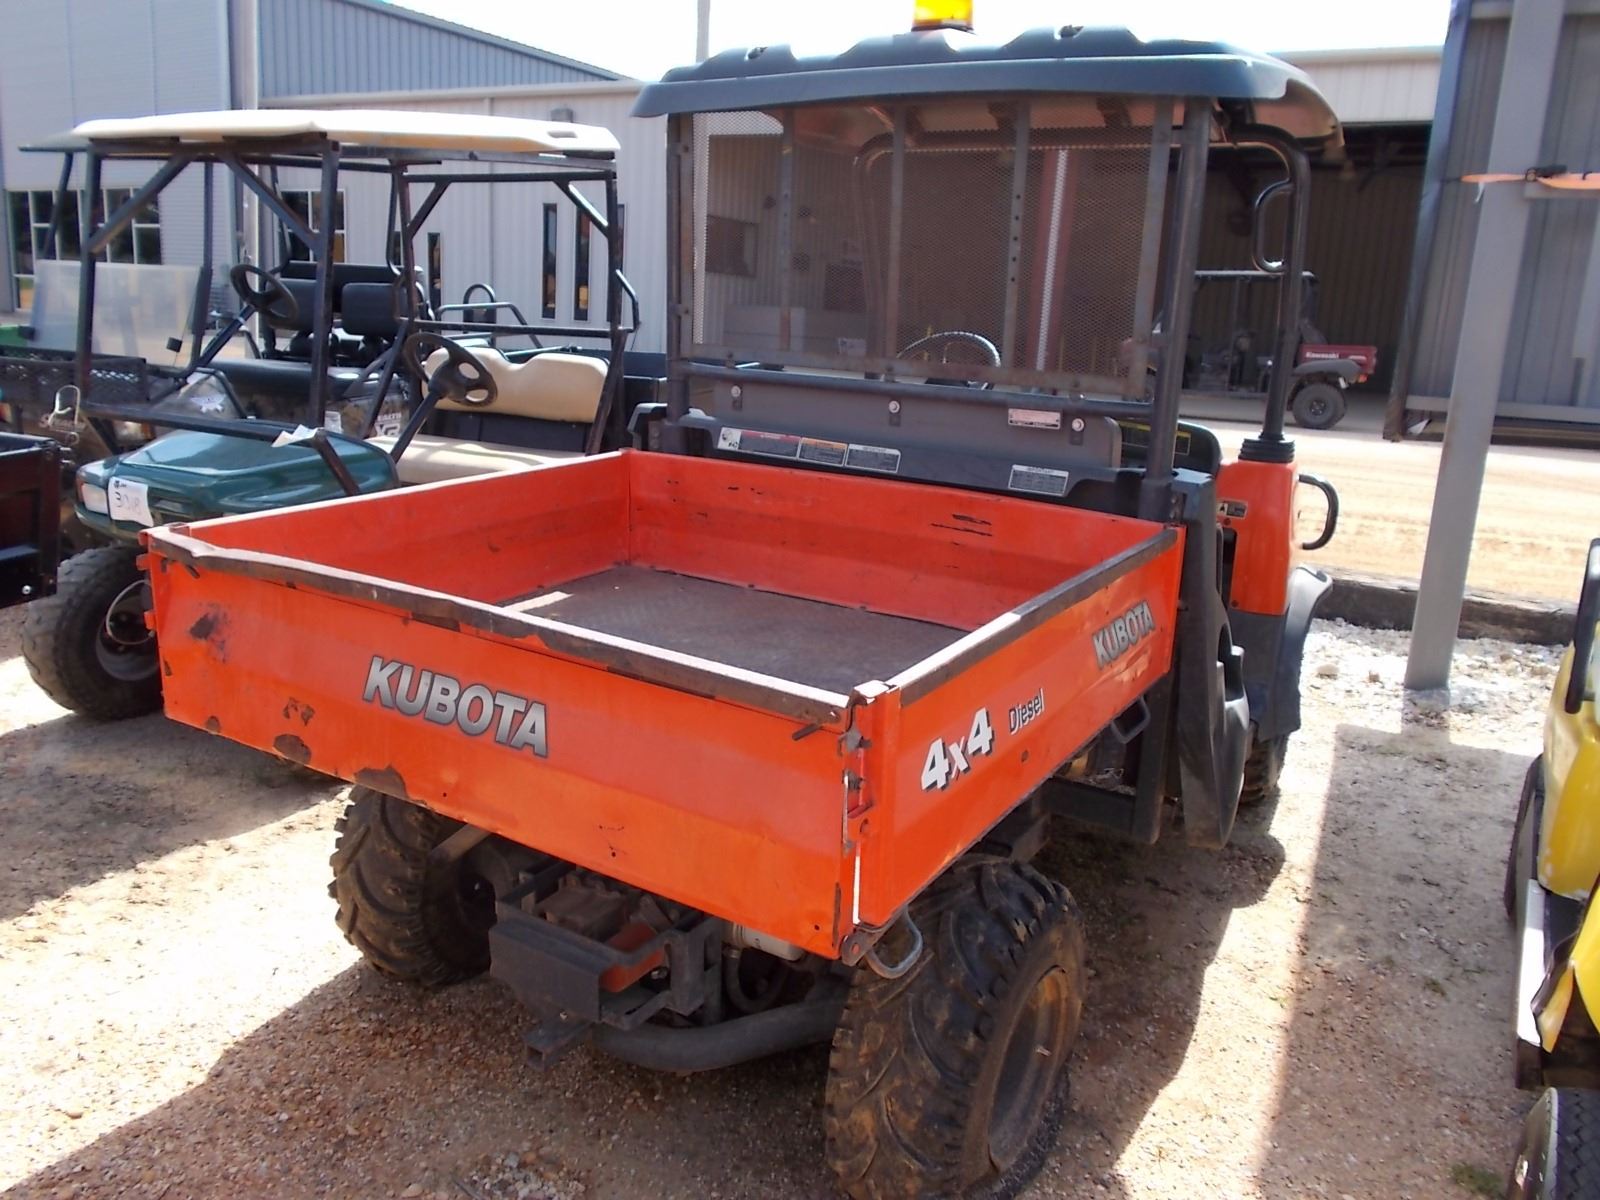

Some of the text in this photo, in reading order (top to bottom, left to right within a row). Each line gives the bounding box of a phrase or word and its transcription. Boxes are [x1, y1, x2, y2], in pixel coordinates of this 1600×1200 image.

[1092, 601, 1156, 670] KUBOTA
[363, 655, 548, 758] KUBOTA
[921, 688, 1045, 791] 4x4 Diesel
